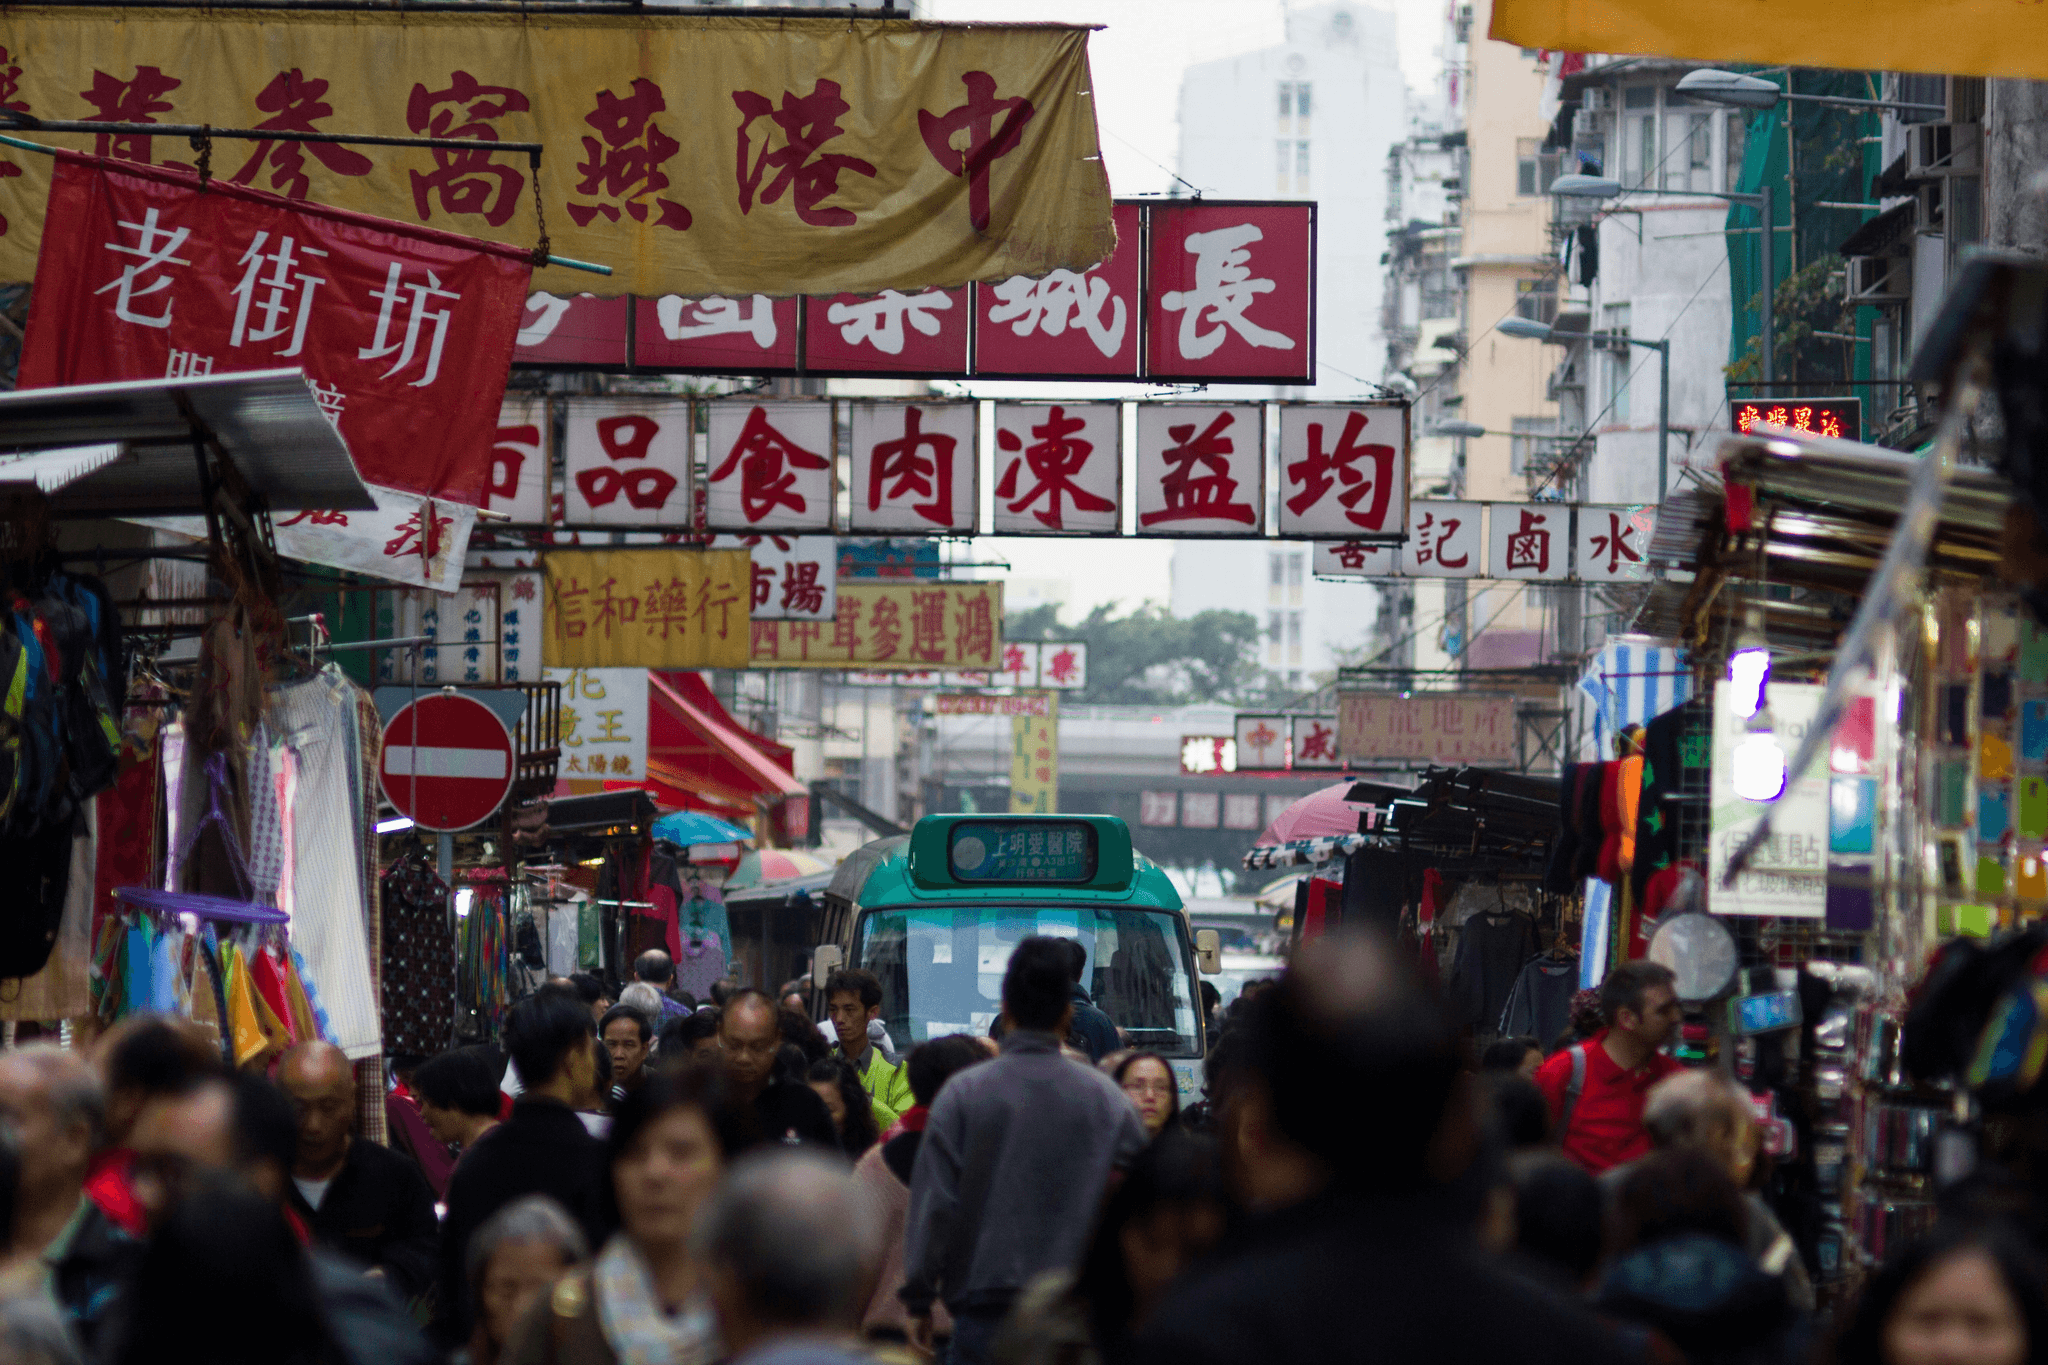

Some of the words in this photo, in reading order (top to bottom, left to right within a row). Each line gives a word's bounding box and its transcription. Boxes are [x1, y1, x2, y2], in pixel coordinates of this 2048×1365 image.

[94, 207, 460, 387] 老街坊
[547, 577, 740, 640] 信和藥行
